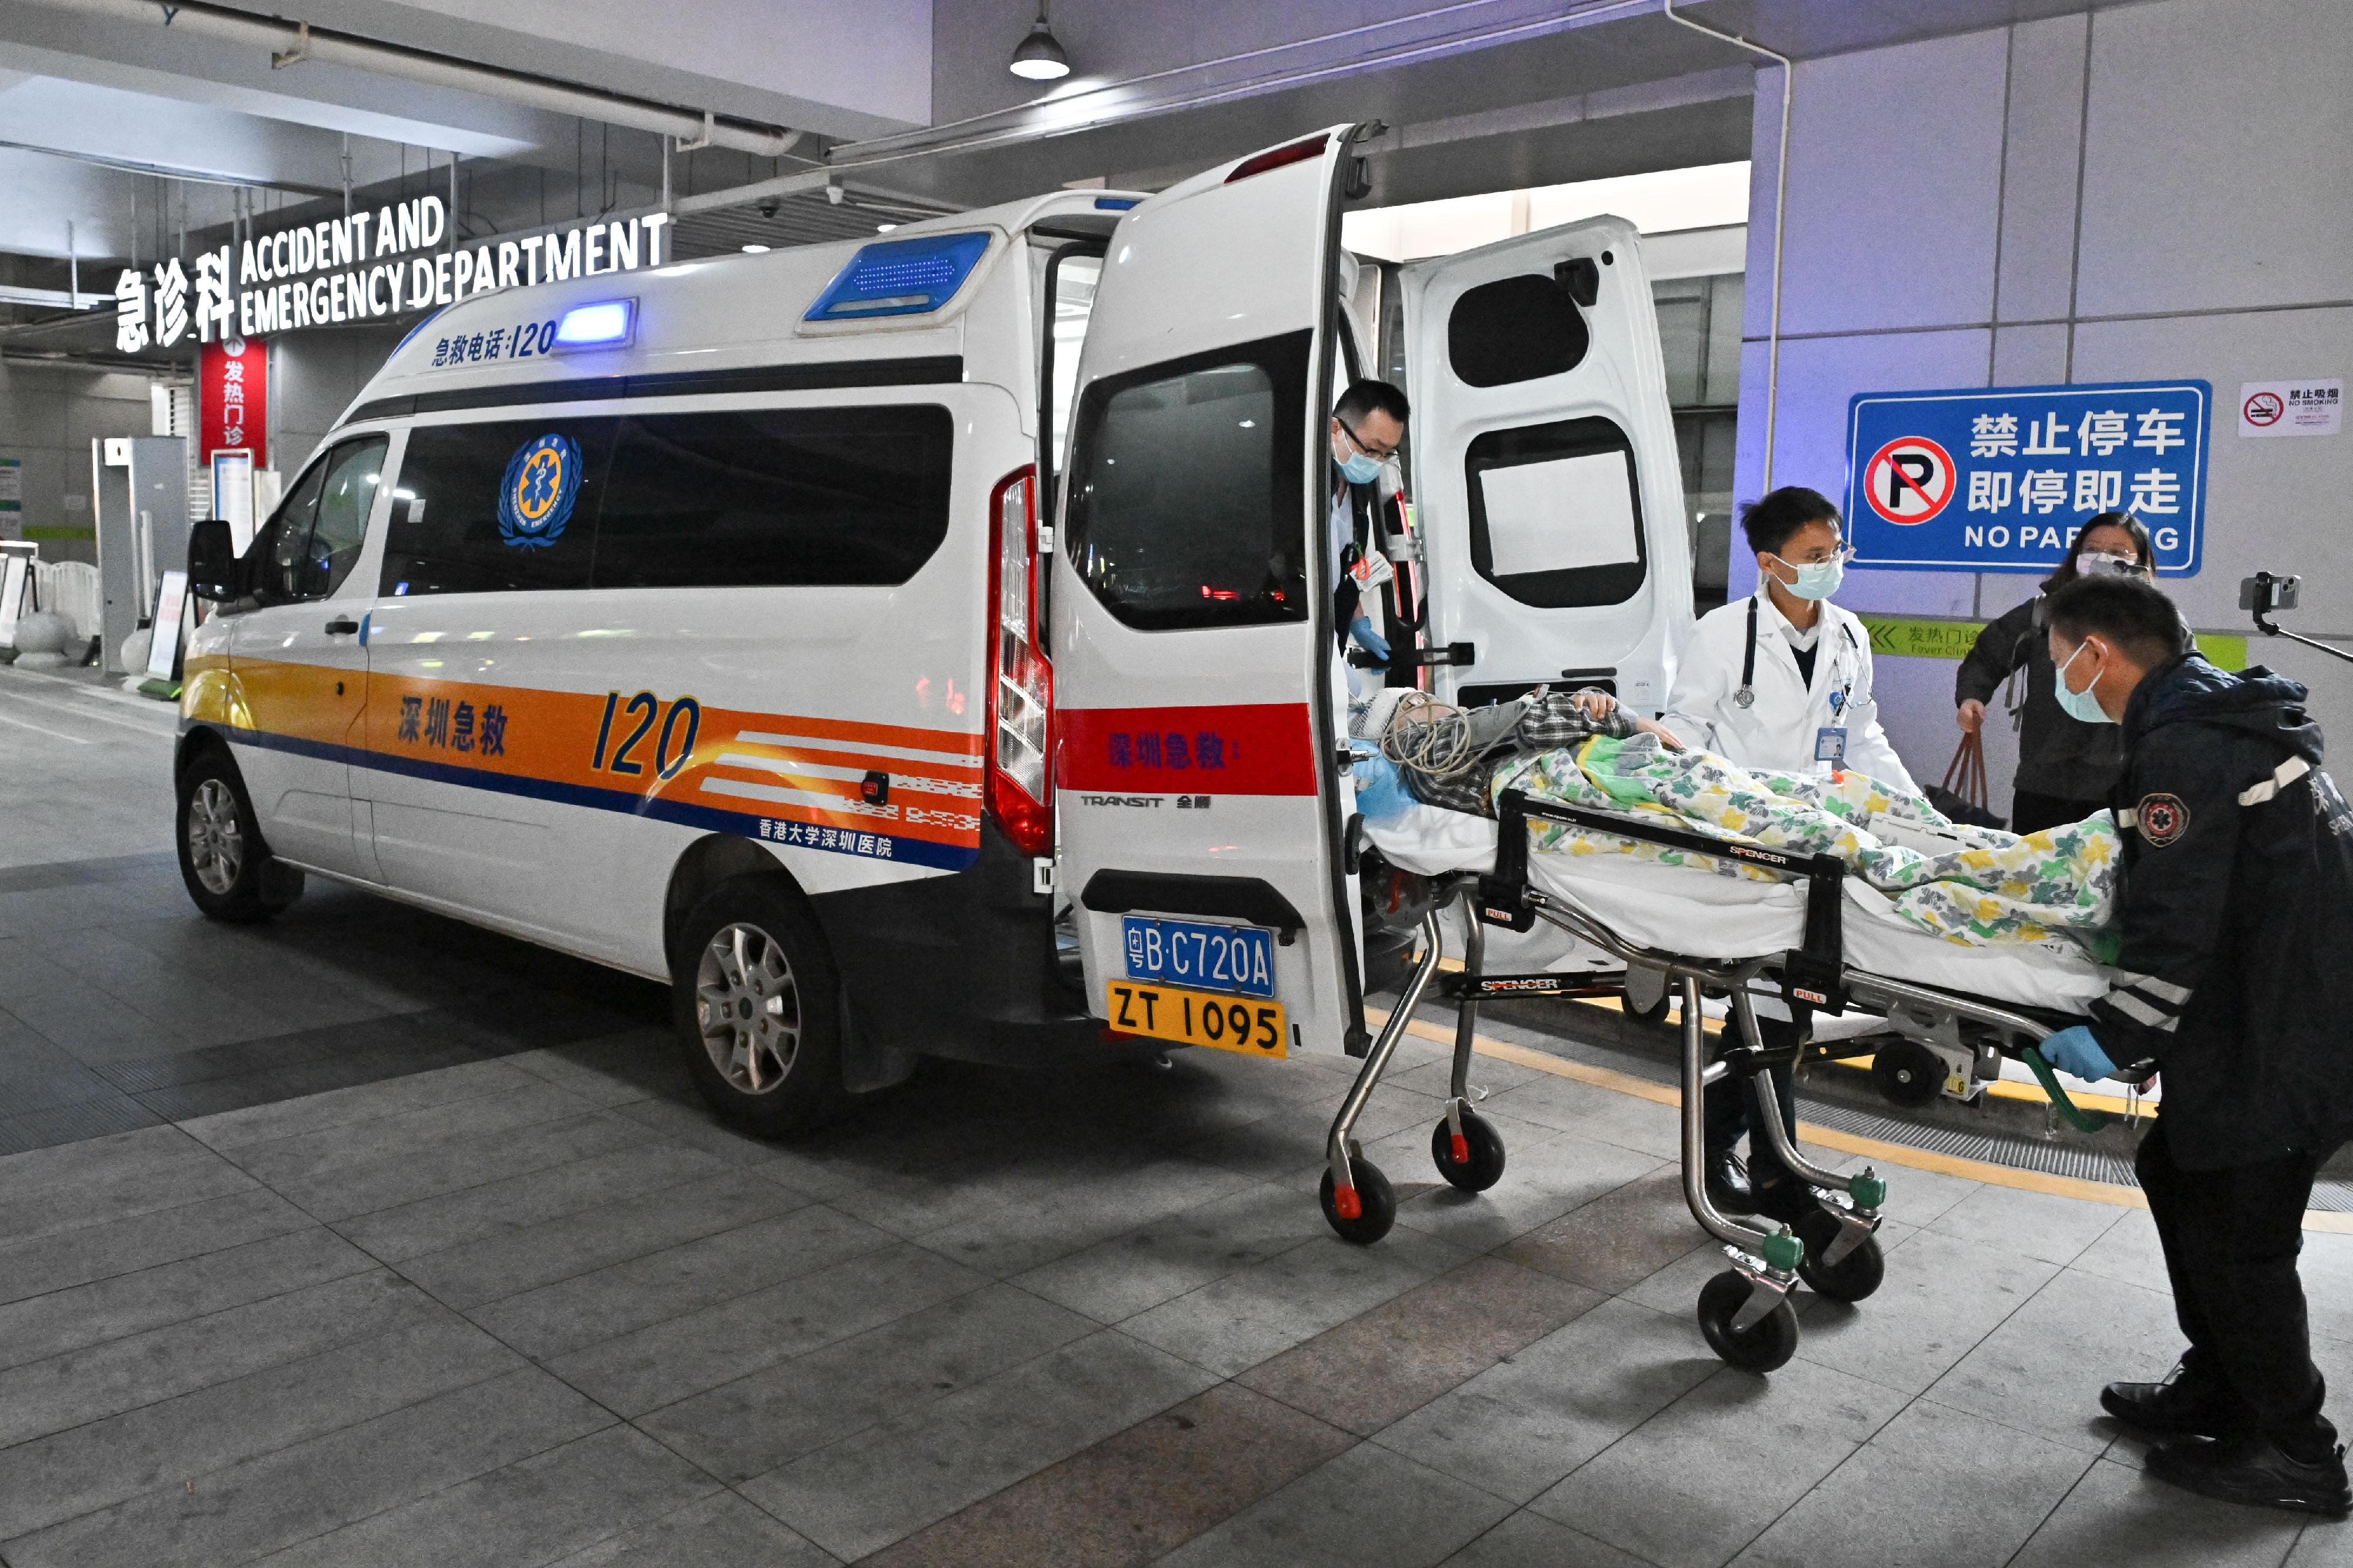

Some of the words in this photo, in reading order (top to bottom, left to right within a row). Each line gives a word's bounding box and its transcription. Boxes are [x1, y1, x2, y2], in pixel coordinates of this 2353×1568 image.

[241, 212, 369, 285] ACCIDENT
[375, 196, 444, 257] AND
[241, 262, 404, 336] EMERGENCY
[412, 213, 668, 308] DEPARTMENT
[115, 245, 235, 352] 急诊科
[224, 361, 244, 446] 发热门诊
[2289, 388, 2339, 400] 禁止吸烟
[1970, 408, 2185, 458] 禁止停车
[1968, 468, 2181, 515] 即停即走
[1965, 526, 2010, 548] NO
[1911, 645, 1942, 655] Fever
[398, 695, 508, 757] 深圳急救
[591, 690, 701, 780] 120
[1081, 795, 1165, 808] TRANSIT
[759, 819, 892, 858] 香港大学深圳医院
[1729, 846, 1787, 865] SPENCER
[1487, 909, 1509, 921] PULL
[1481, 979, 1558, 991] SPENCER
[1796, 990, 1823, 1003] PULL
[1114, 987, 1159, 1030] ZT
[1184, 997, 1278, 1050] 1095
